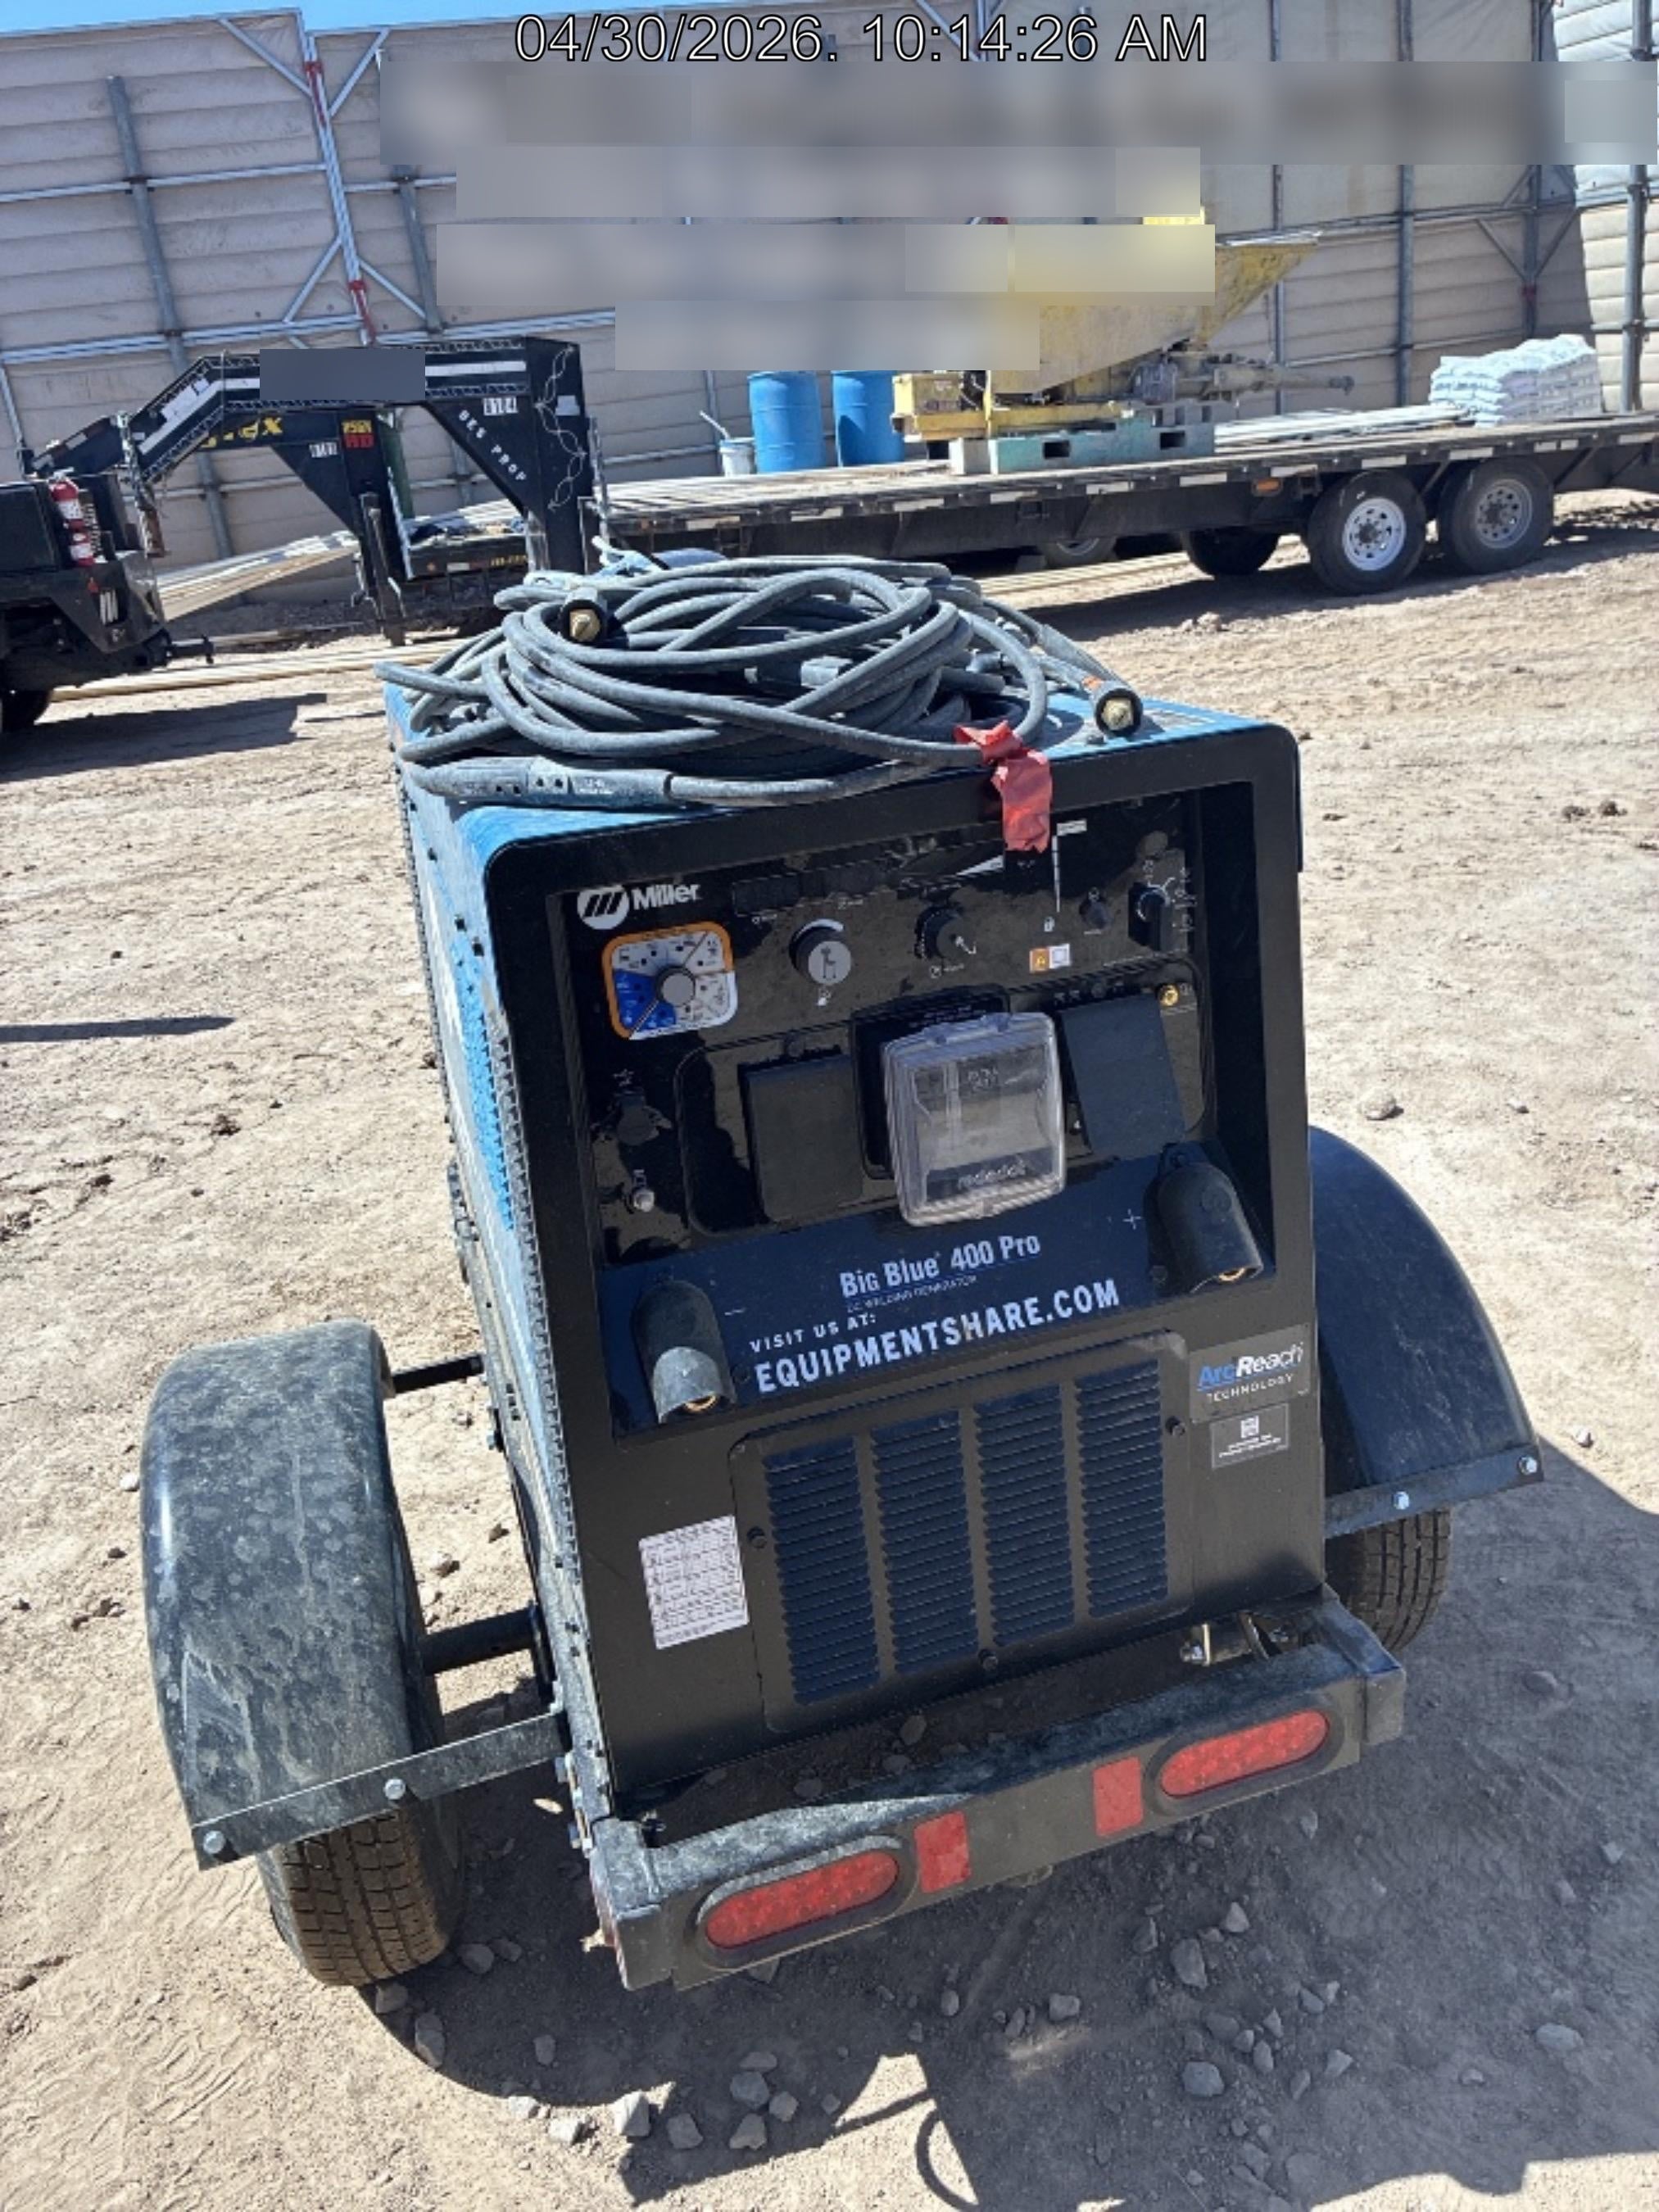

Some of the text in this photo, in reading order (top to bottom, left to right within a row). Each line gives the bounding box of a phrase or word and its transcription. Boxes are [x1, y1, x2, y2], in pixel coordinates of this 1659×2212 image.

[631, 885, 701, 911] Miller
[950, 1240, 994, 1272] 400
[999, 1235, 1040, 1260] Pro
[750, 1312, 877, 1353] VISIT US AT:
[755, 1279, 1121, 1393] EQUIPMENTSHARE.COM
